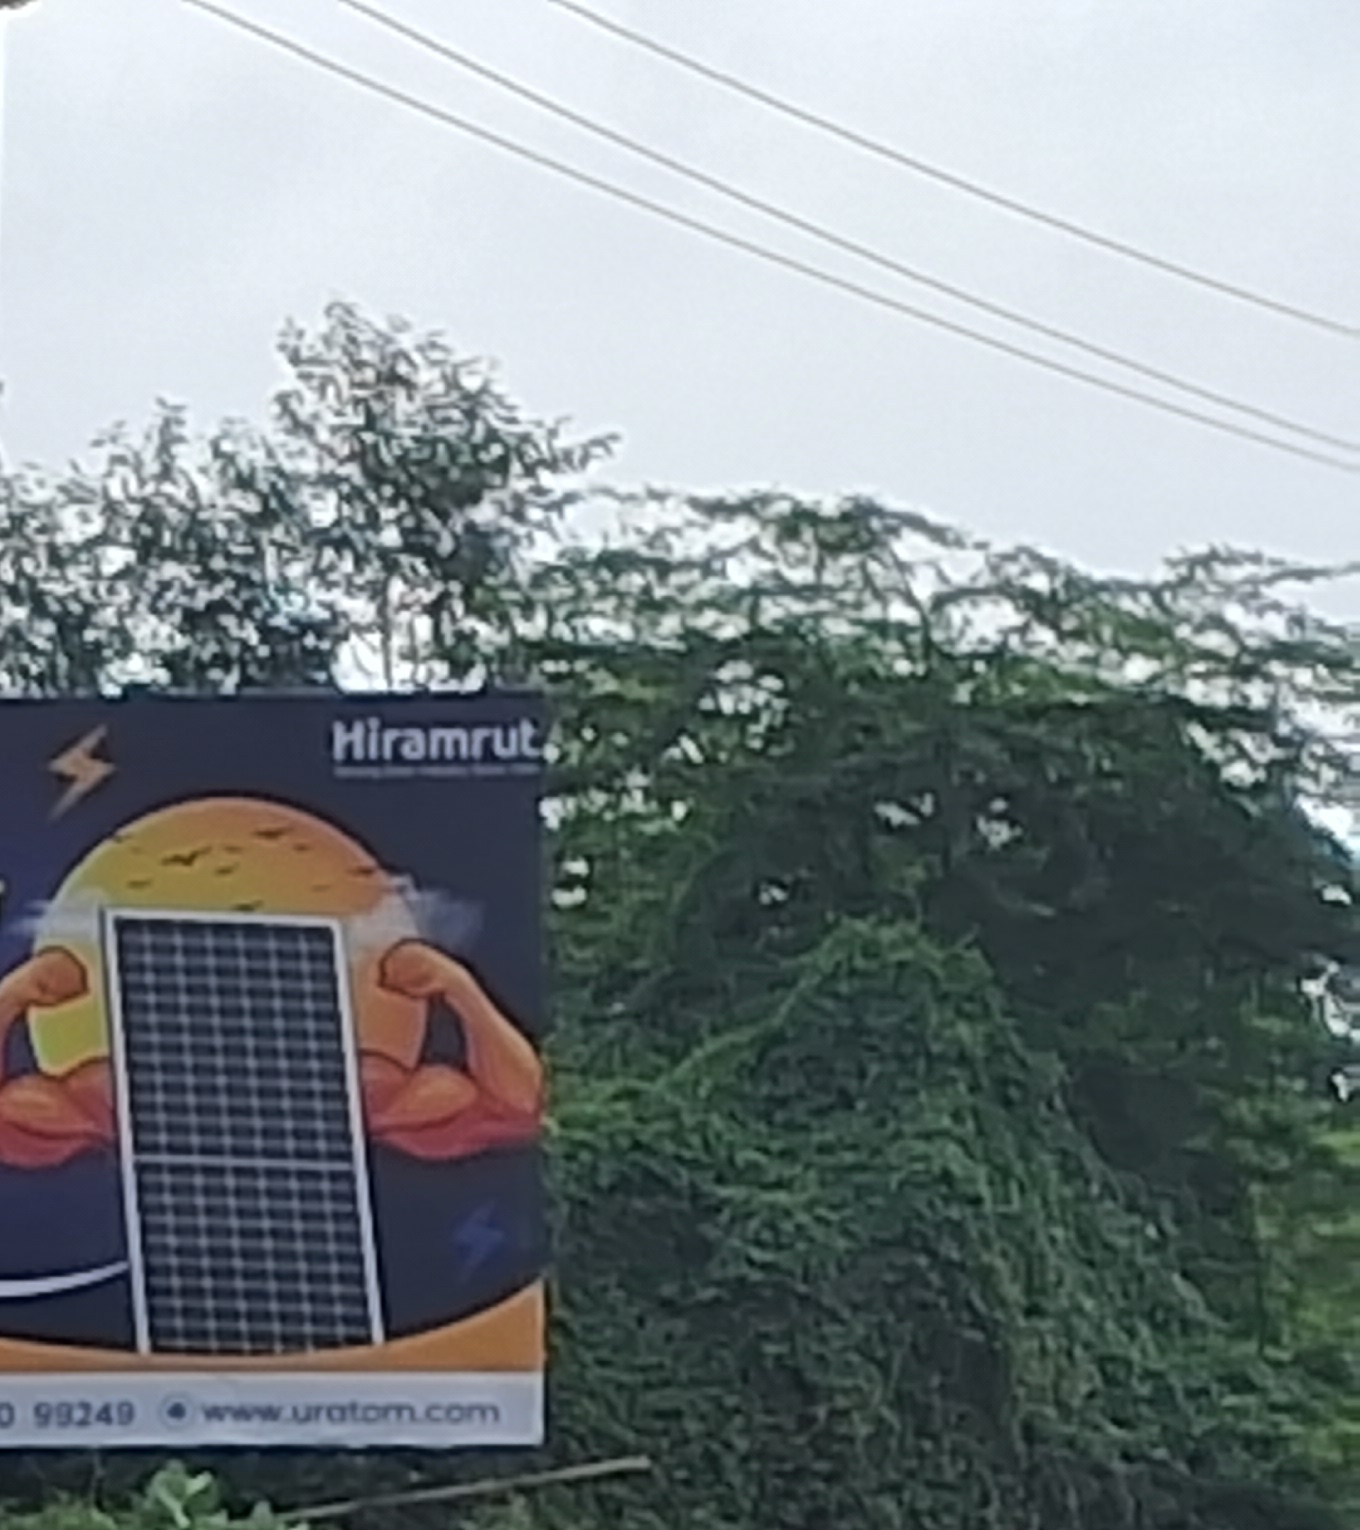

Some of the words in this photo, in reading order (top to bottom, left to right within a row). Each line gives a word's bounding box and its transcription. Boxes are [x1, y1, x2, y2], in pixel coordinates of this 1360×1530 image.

[333, 717, 541, 761] Hiramrut
[32, 1401, 135, 1428] 99249
[203, 1400, 500, 1425] www.uratom.com
